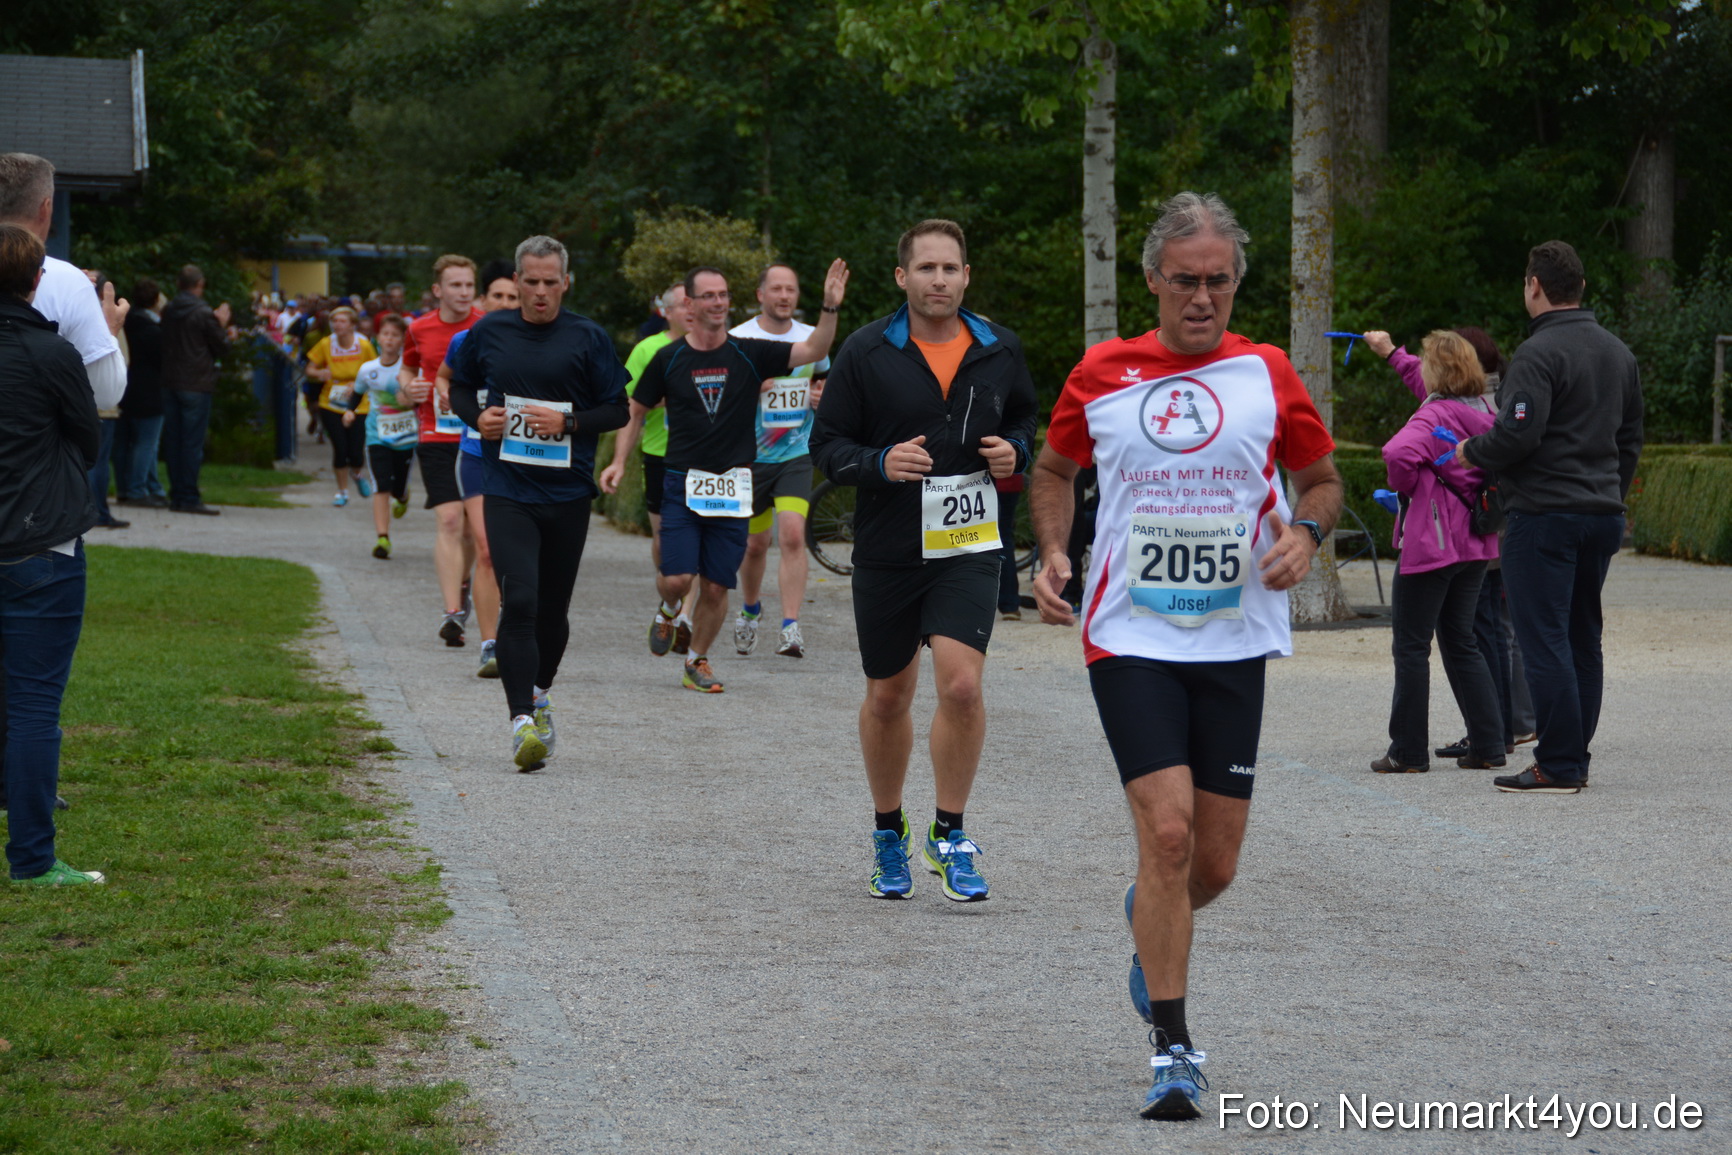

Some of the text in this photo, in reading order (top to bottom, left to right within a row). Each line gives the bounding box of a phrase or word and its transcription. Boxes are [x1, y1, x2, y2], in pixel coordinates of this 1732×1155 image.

[767, 390, 806, 409] 2187
[773, 413, 803, 421] Benjamin
[524, 445, 544, 457] Tom
[1120, 466, 1248, 482] LAUFEN MIT HERZ
[693, 478, 736, 497] 2598
[925, 479, 983, 493] PARTL Neumarkt
[1183, 488, 1197, 497] Dr.
[705, 500, 726, 509] Frank
[942, 490, 986, 526] 294
[949, 531, 979, 545] Tobias
[1132, 524, 1231, 538] PARTL Neumarkt
[1140, 542, 1240, 584] 2055
[1168, 594, 1211, 611] Josef
